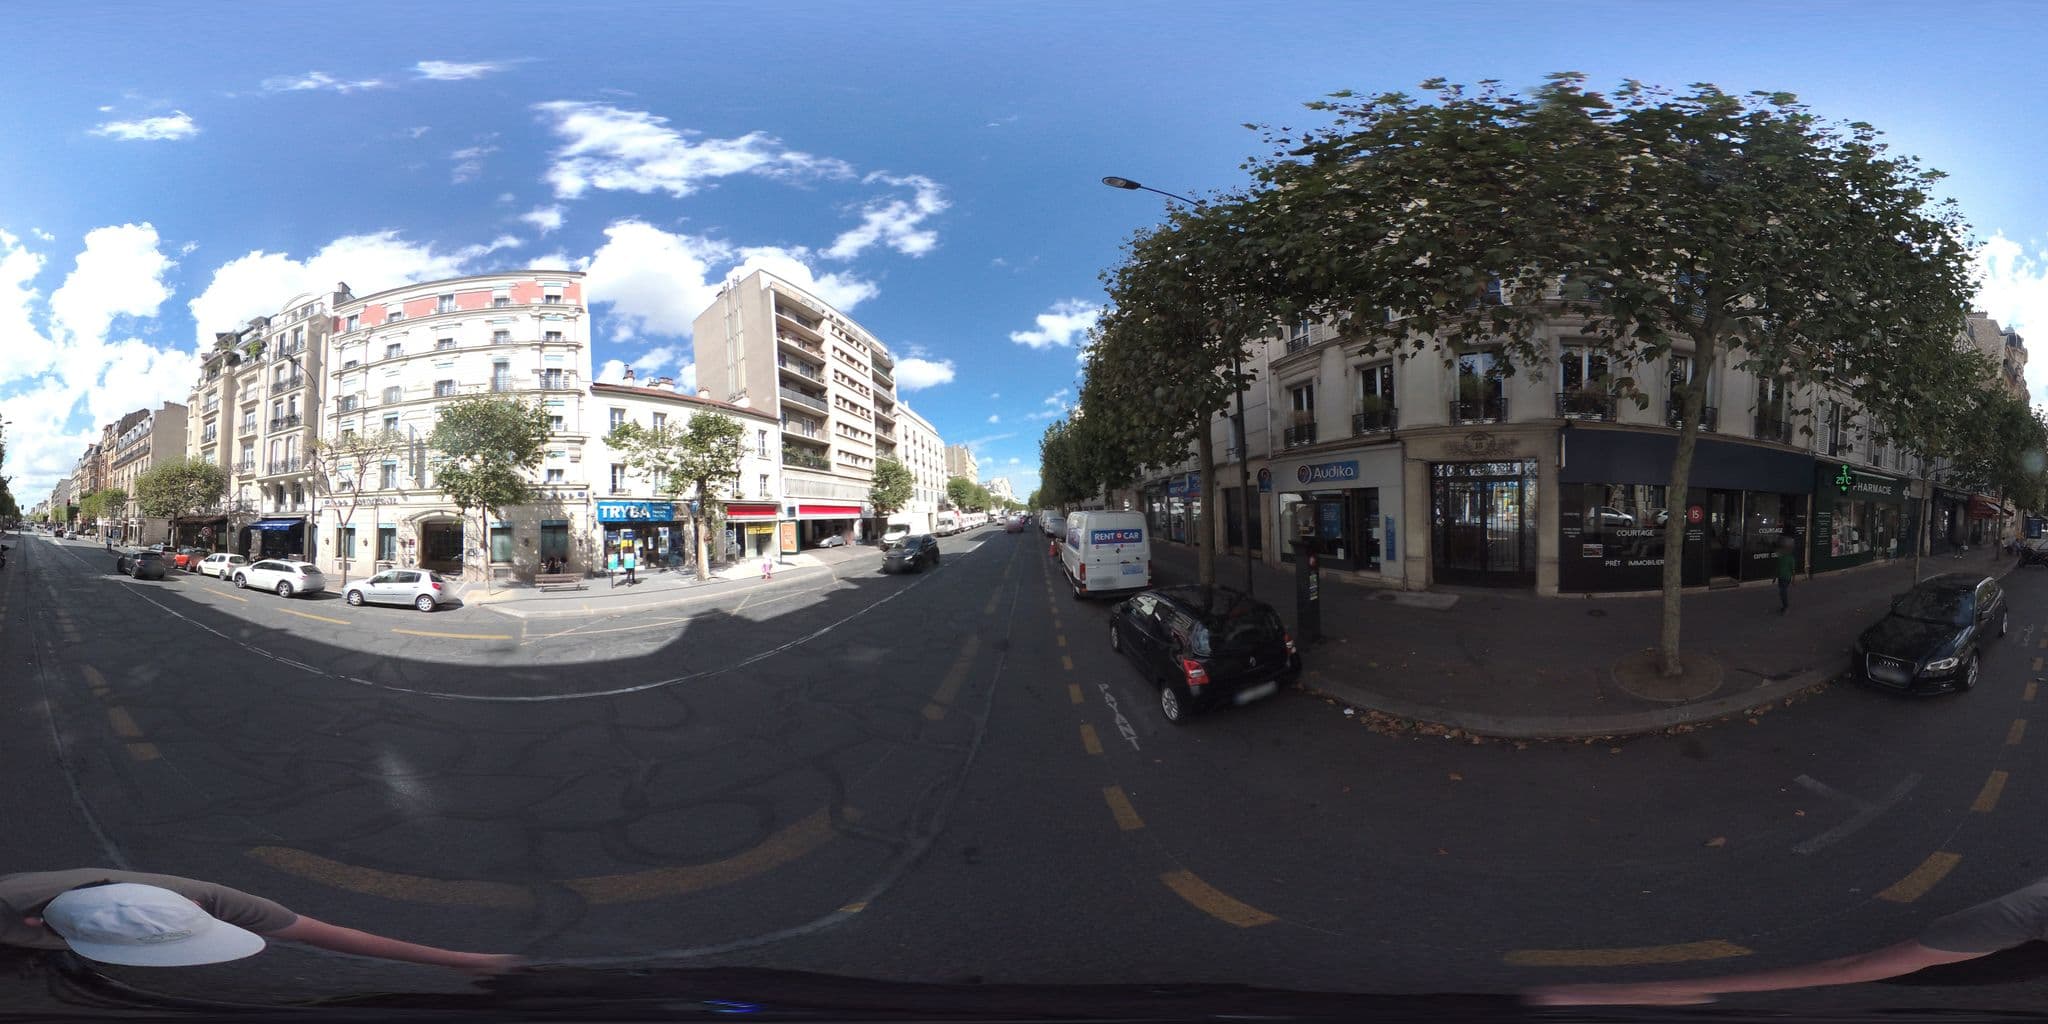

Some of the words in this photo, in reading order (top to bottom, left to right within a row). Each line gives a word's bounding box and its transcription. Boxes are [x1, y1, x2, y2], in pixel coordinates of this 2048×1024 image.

[1313, 465, 1354, 479] Audika
[599, 505, 651, 519] TRYBA
[1692, 509, 1700, 519] 15
[1094, 532, 1115, 541] RENT
[1123, 532, 1139, 540] CAR
[1616, 529, 1654, 537] COURTAGE
[1605, 558, 1621, 567] PRÊT
[1098, 682, 1141, 752] PAYANT
